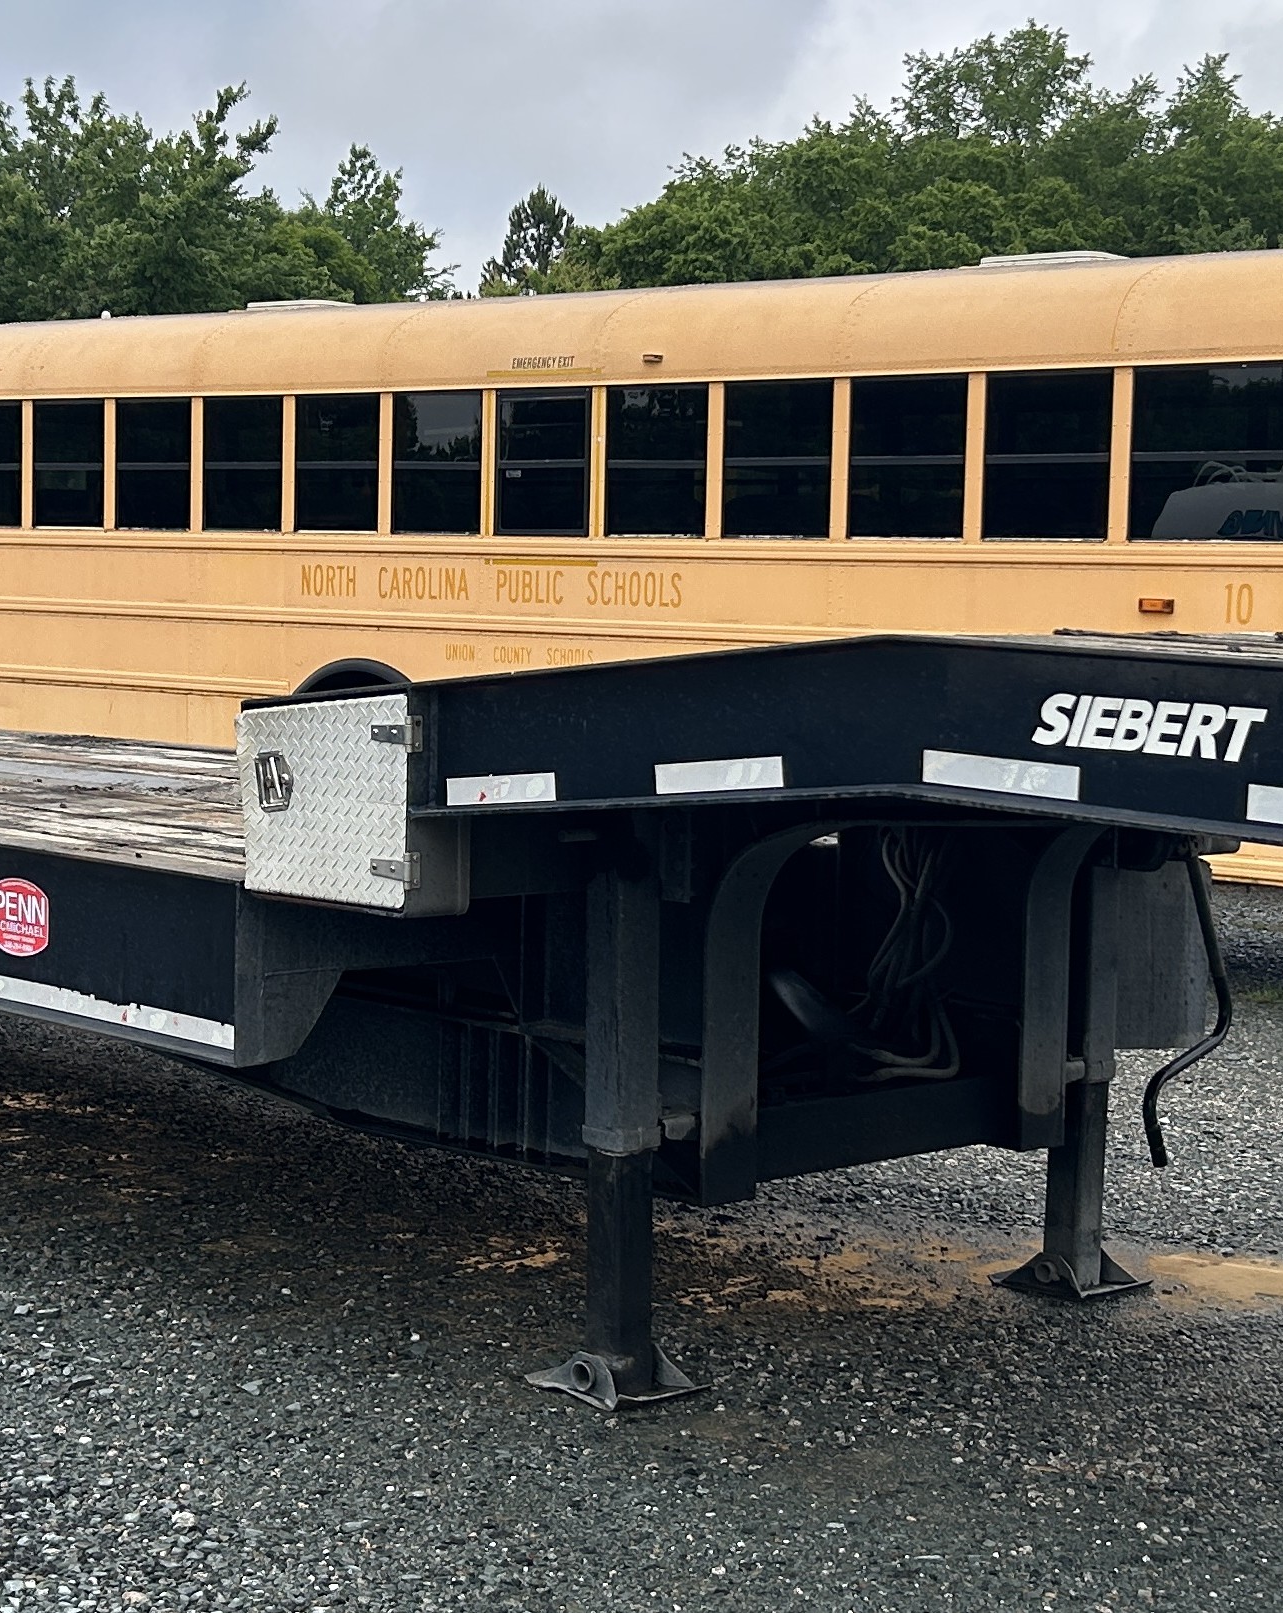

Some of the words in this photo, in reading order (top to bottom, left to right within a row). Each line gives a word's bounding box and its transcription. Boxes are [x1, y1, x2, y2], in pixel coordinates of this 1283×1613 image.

[511, 356, 557, 370] EMERGENCY
[557, 355, 575, 368] EXIT
[301, 564, 357, 597] NORTH
[378, 566, 469, 601] CAROLINA
[496, 569, 564, 605] PUBLIC
[586, 570, 682, 609] SCHOOLS
[1224, 583, 1253, 625] 10
[445, 643, 476, 662] UNION
[493, 645, 533, 664] COUNTY
[1031, 692, 1268, 763] SIEBERT
